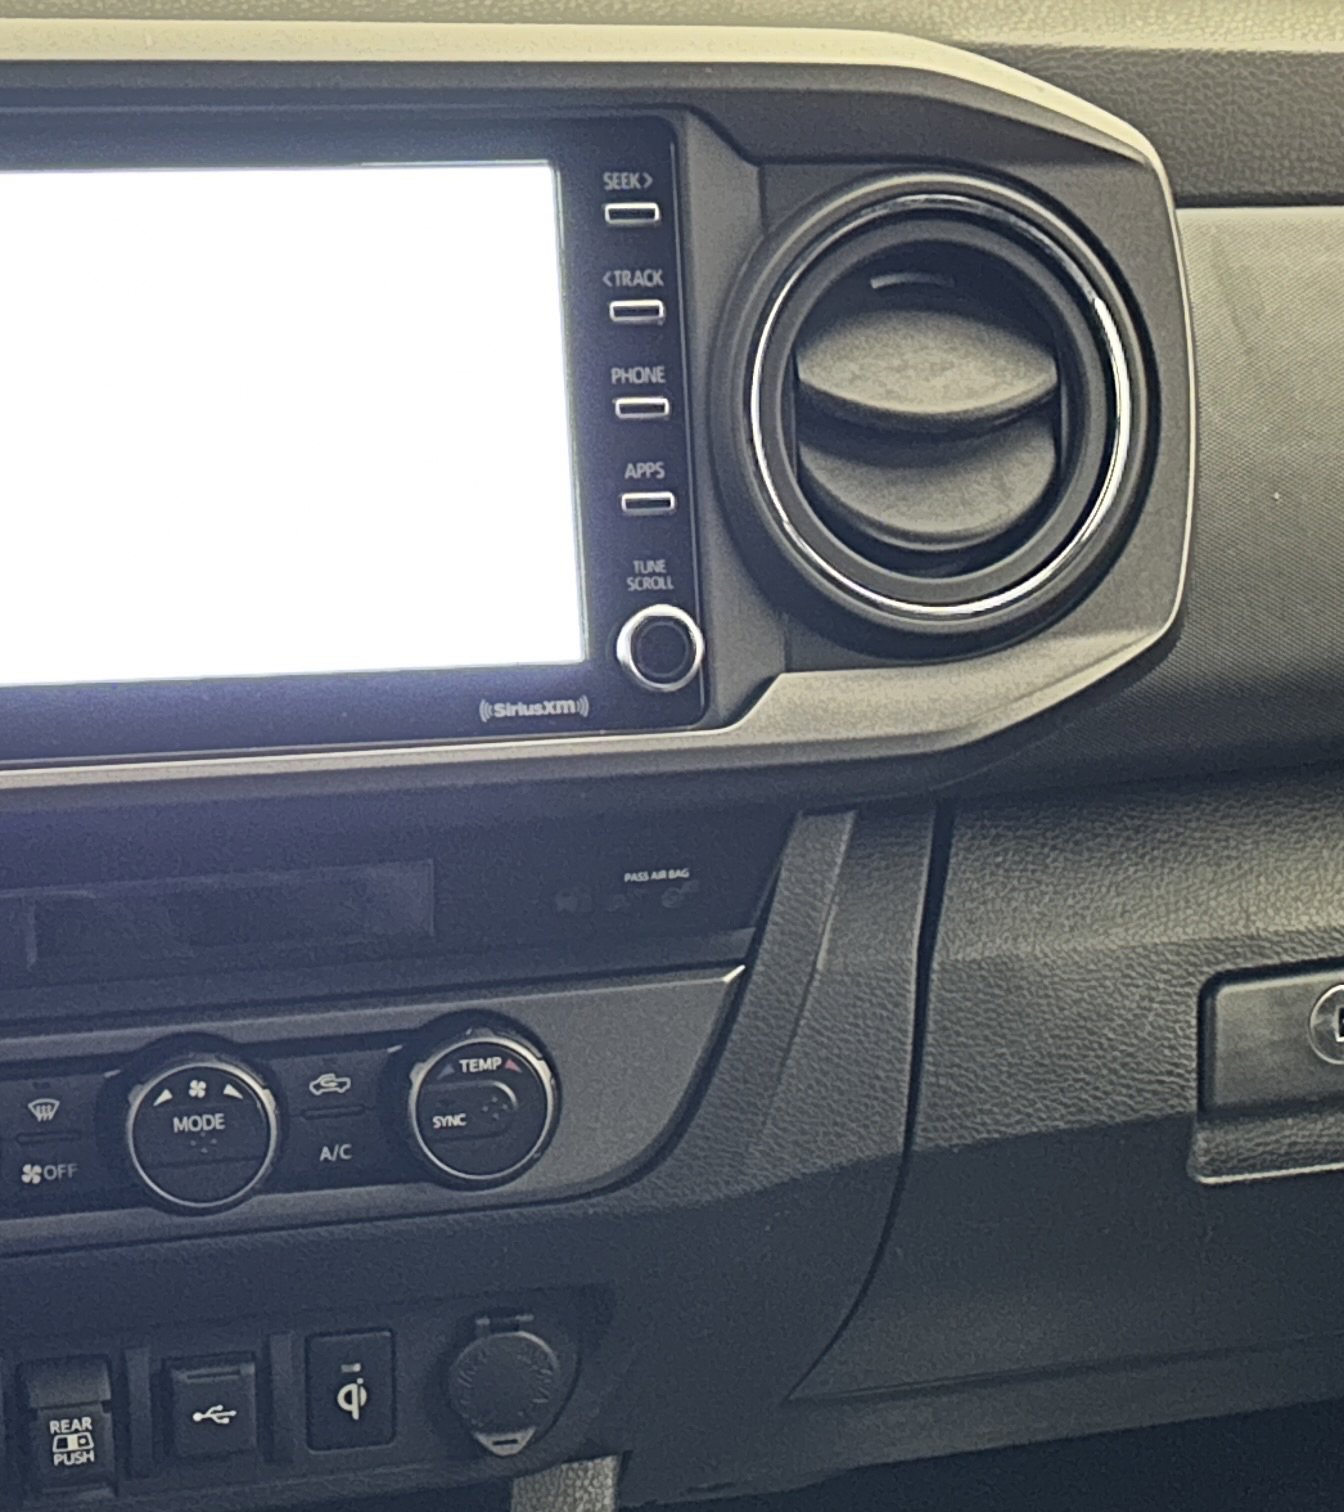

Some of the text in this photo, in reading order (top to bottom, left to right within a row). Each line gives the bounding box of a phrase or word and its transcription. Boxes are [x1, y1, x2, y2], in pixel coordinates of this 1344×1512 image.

[611, 366, 666, 384] PHONE
[625, 462, 665, 480] APPS
[633, 560, 667, 574] TUNE
[627, 575, 674, 591] SCROLL
[624, 870, 649, 882] PASS
[459, 1056, 503, 1074] TEMP
[173, 1113, 226, 1133] MODE
[433, 1113, 467, 1129] SYNC
[319, 1144, 352, 1162] A/C
[43, 1163, 78, 1181] OFF
[49, 1417, 93, 1435] REAR
[53, 1449, 95, 1467] PUSH
